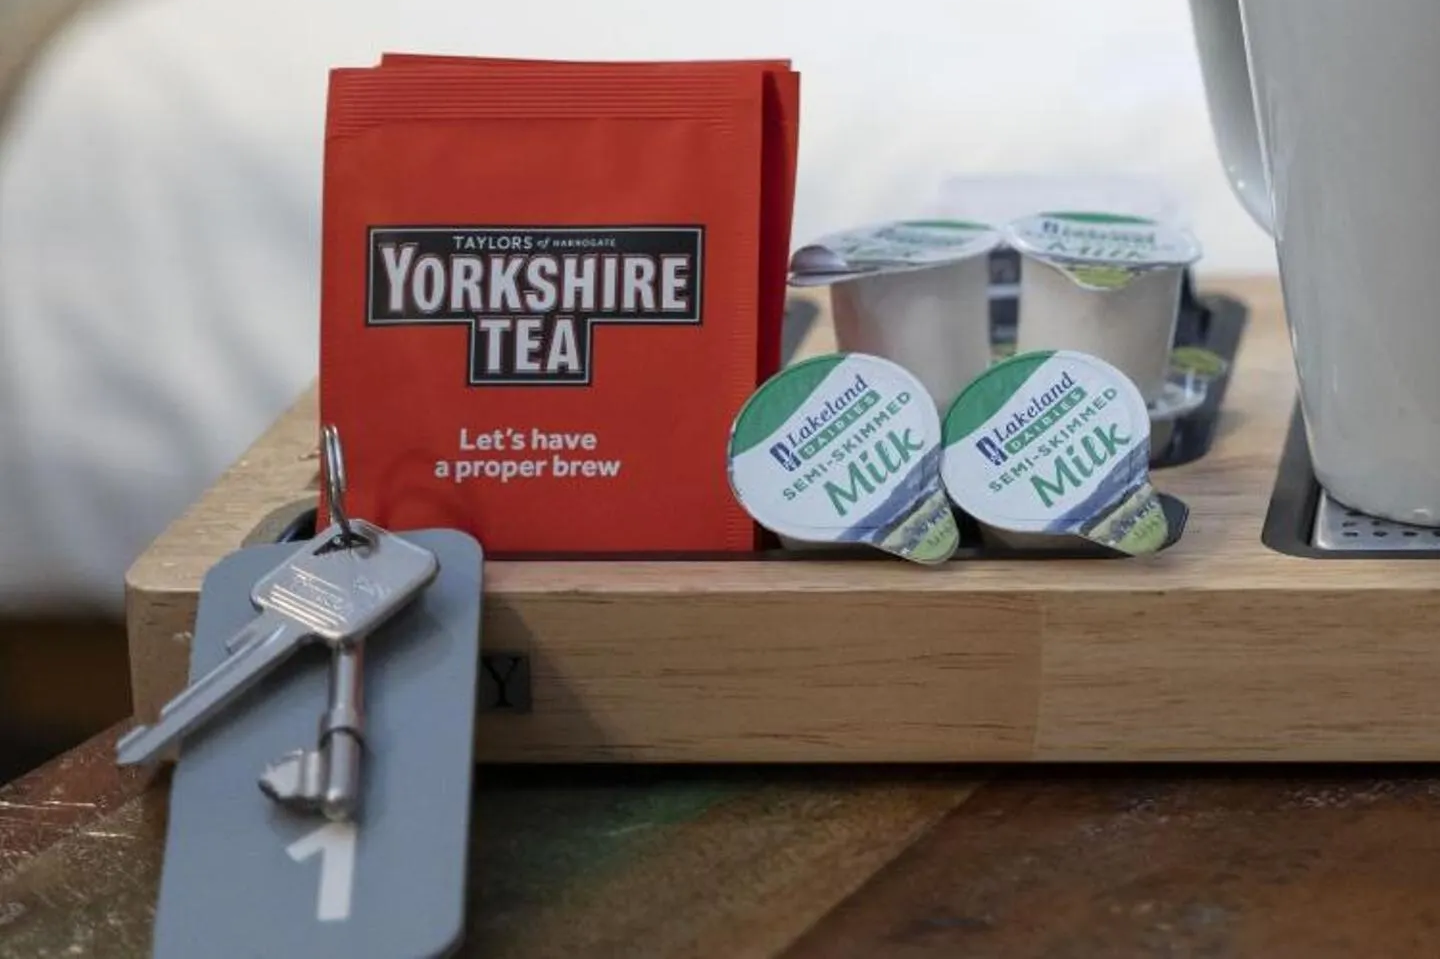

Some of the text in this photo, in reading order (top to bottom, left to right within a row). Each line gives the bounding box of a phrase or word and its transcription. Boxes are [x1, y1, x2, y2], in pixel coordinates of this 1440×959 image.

[452, 236, 617, 249] TAYLORS of HARROGATE
[379, 244, 690, 313] YORKSHIRE
[478, 317, 583, 373] TEA
[459, 428, 598, 450] Let's have
[787, 374, 868, 449] Lakeland
[803, 394, 876, 455] DAIRIES
[989, 388, 1117, 492] SEMI-SKIMMED
[993, 371, 1074, 442] Lakeland
[1012, 390, 1083, 449] DAIRIES
[434, 454, 621, 483] a proper brew
[783, 392, 911, 501] SEMI-SKIMMED
[823, 428, 924, 516] Milk
[1030, 423, 1131, 508] Milk
[285, 820, 357, 921] 1
